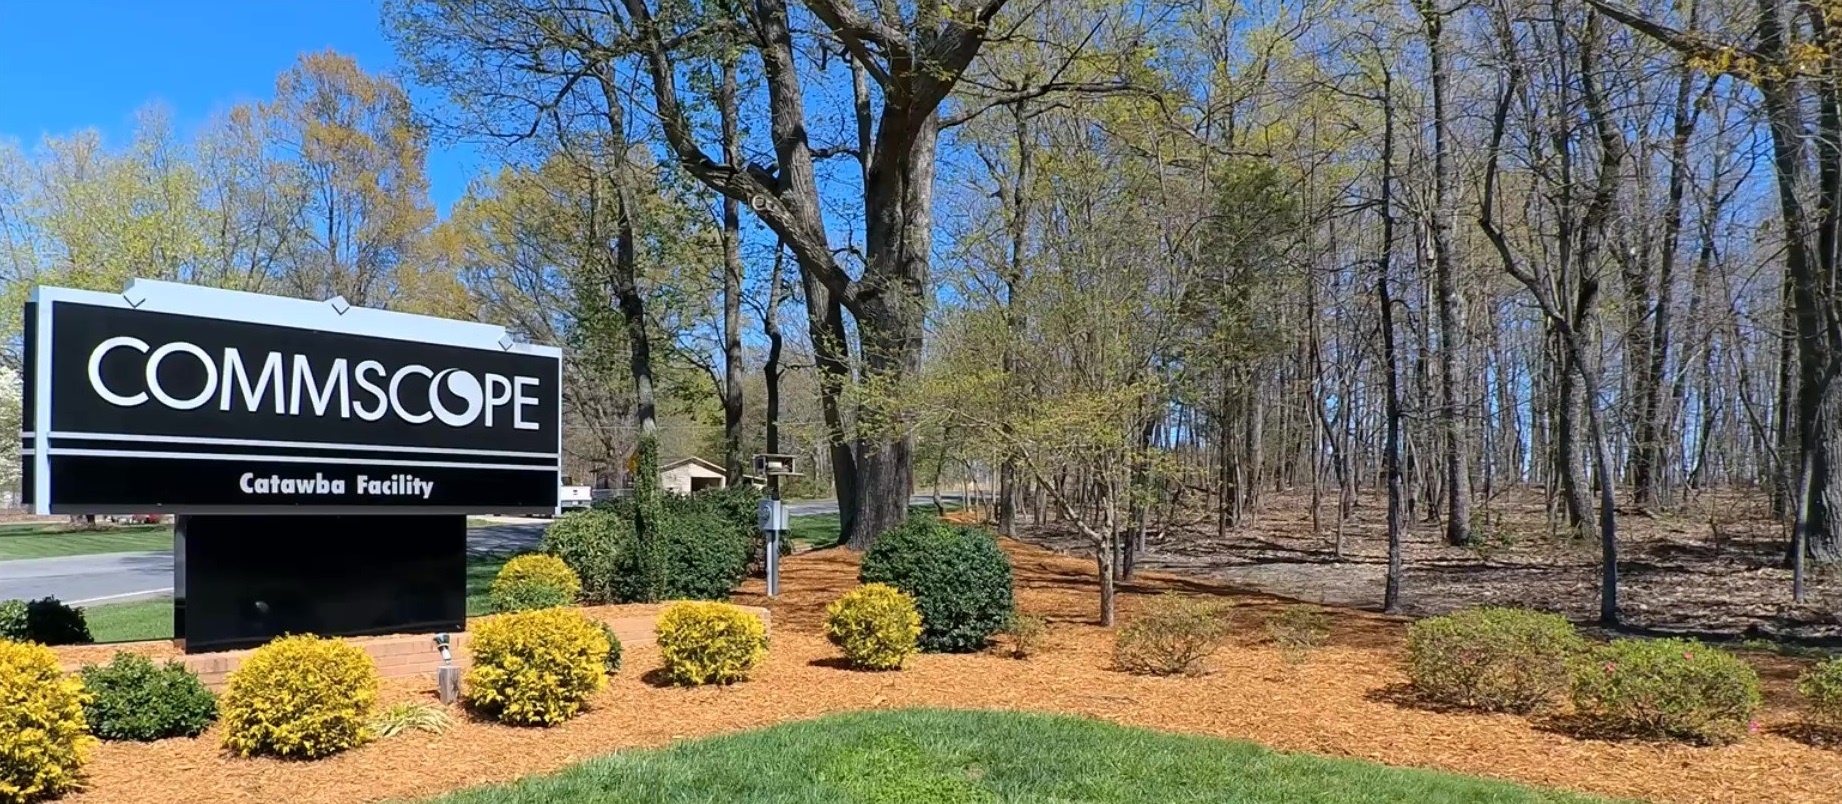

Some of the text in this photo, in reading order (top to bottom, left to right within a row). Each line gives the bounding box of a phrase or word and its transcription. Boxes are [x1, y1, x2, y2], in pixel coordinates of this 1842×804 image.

[87, 336, 540, 430] COMMSCOPE
[239, 472, 434, 499] Catawba Facility
